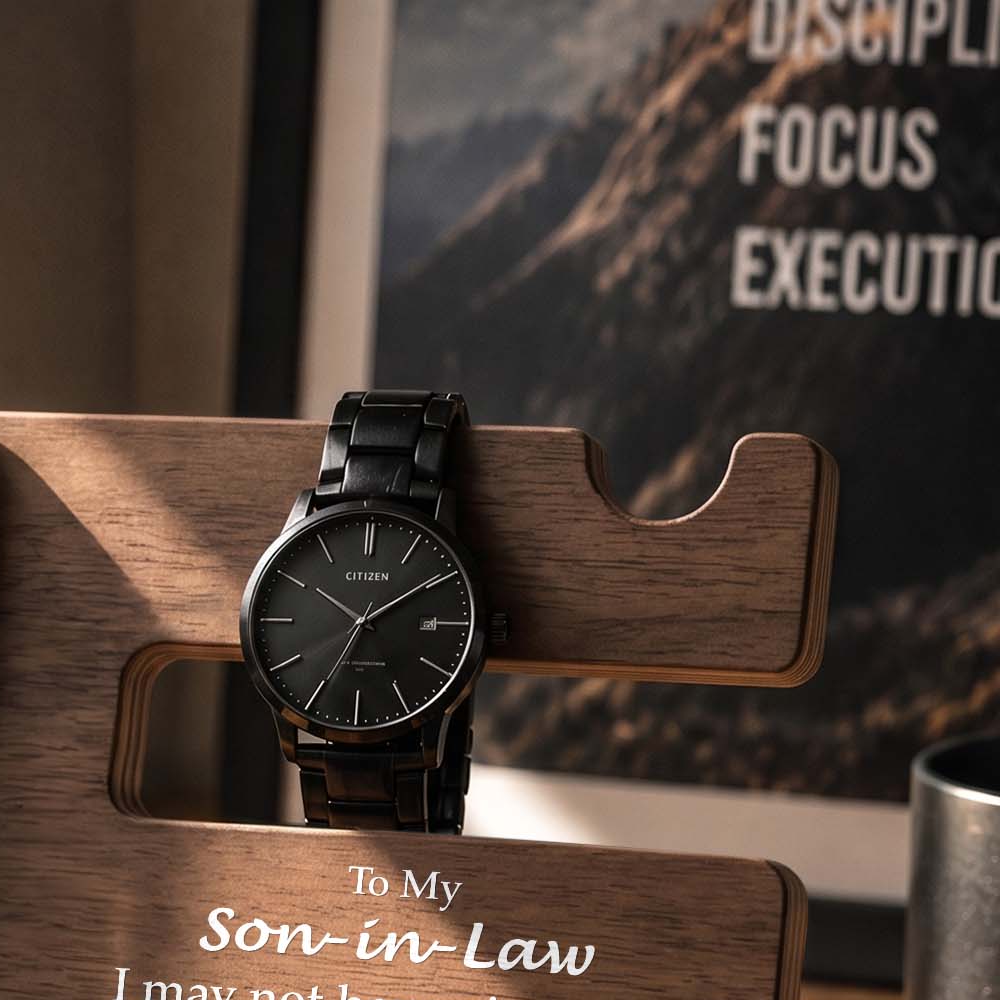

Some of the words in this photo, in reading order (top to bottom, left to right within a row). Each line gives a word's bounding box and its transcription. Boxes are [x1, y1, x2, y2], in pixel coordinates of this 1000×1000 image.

[738, 105, 938, 190] FOCUS
[345, 571, 389, 581] CITIZEN
[348, 865, 389, 897] To
[399, 869, 463, 912] My
[199, 906, 596, 976] Son-in-Law
